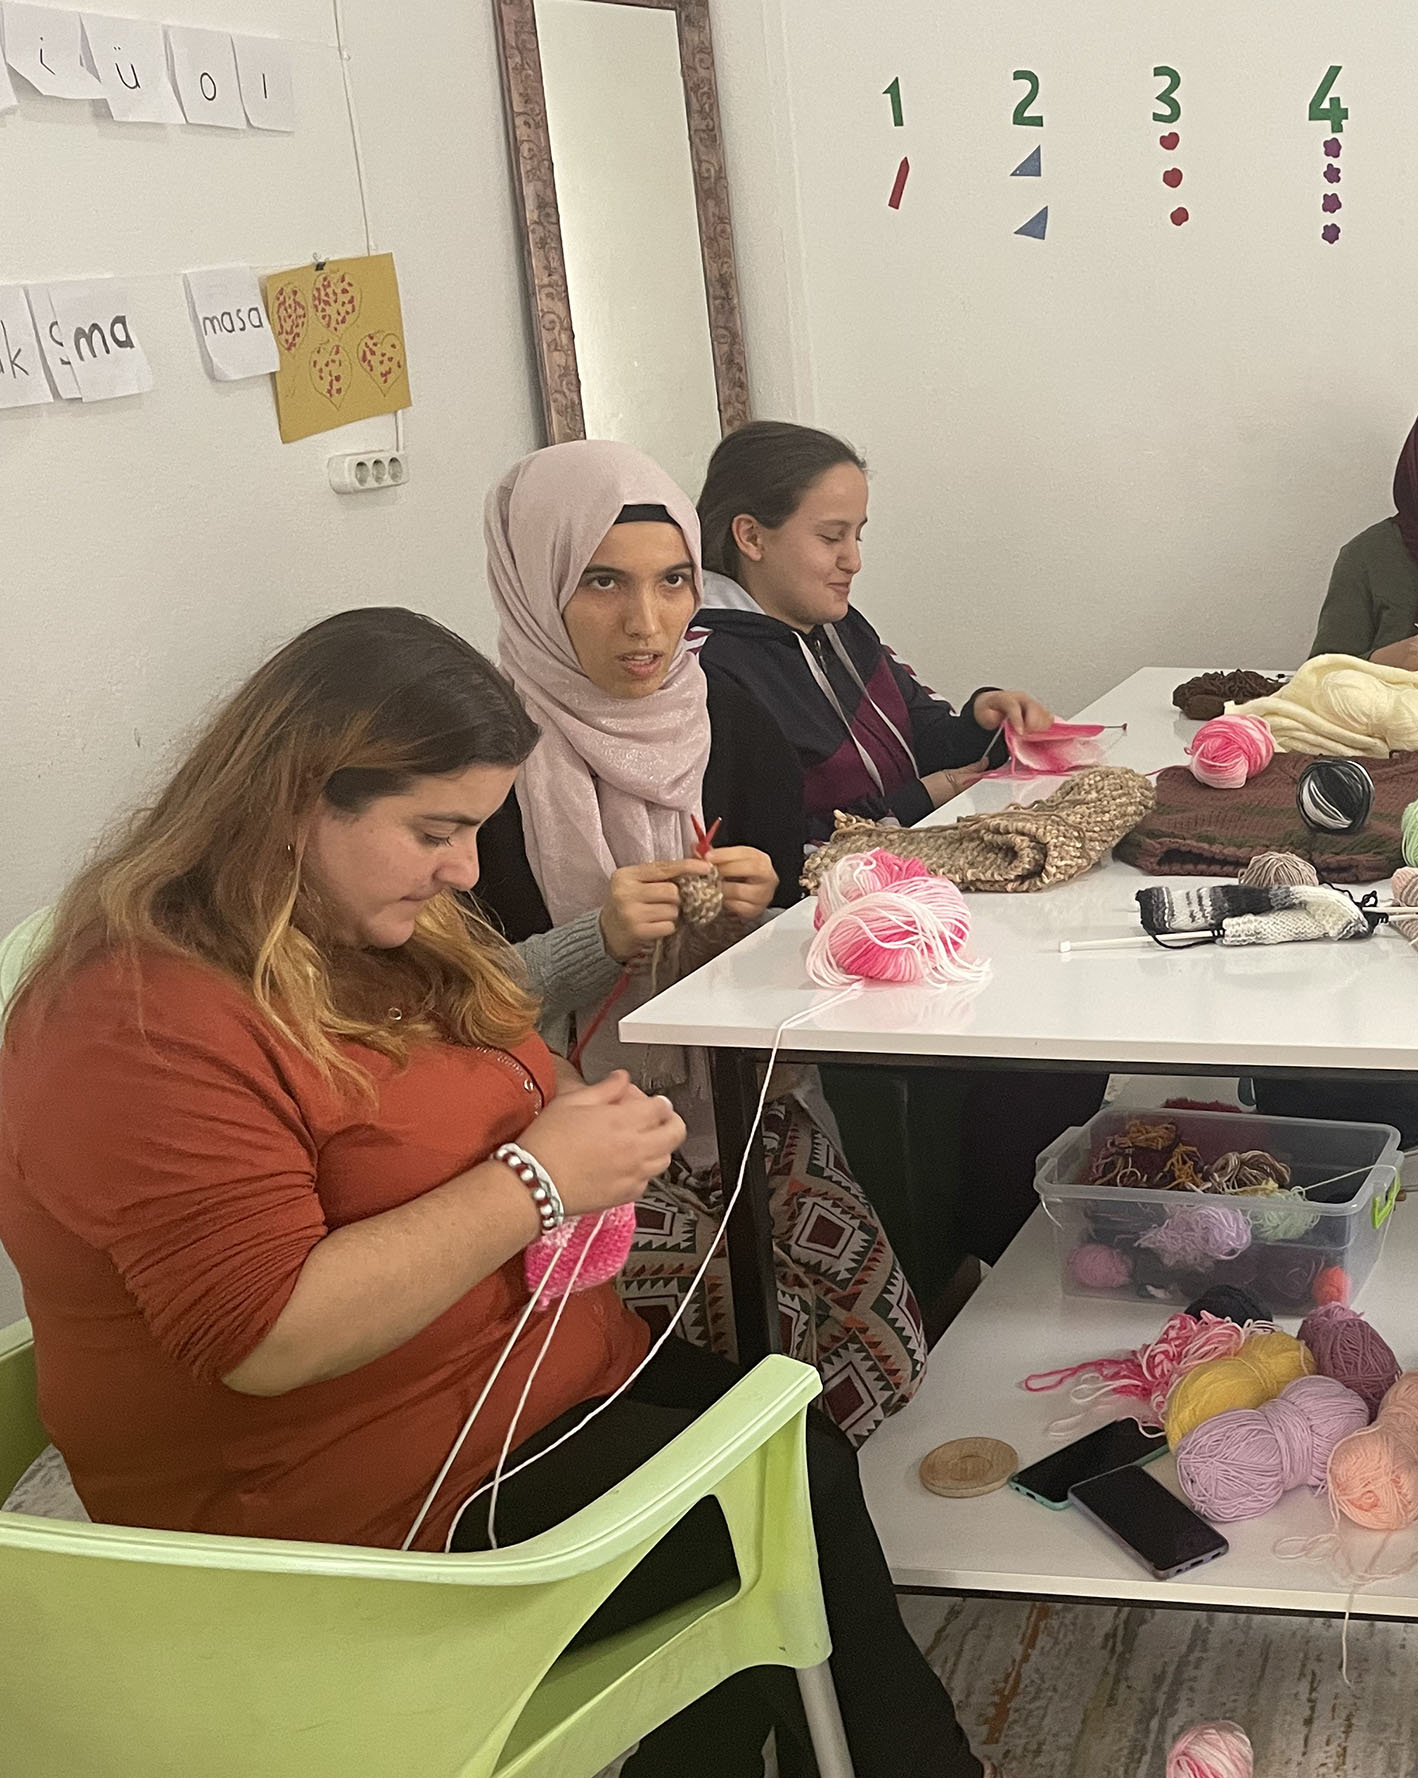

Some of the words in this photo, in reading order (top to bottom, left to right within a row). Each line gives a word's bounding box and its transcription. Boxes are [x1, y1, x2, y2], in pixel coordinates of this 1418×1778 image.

[113, 46, 141, 89] ü
[882, 76, 904, 127] 1
[1012, 69, 1044, 128] 2
[1152, 65, 1181, 123] 3
[1308, 65, 1349, 133] 4
[74, 315, 135, 362] ma
[203, 307, 264, 336] masa
